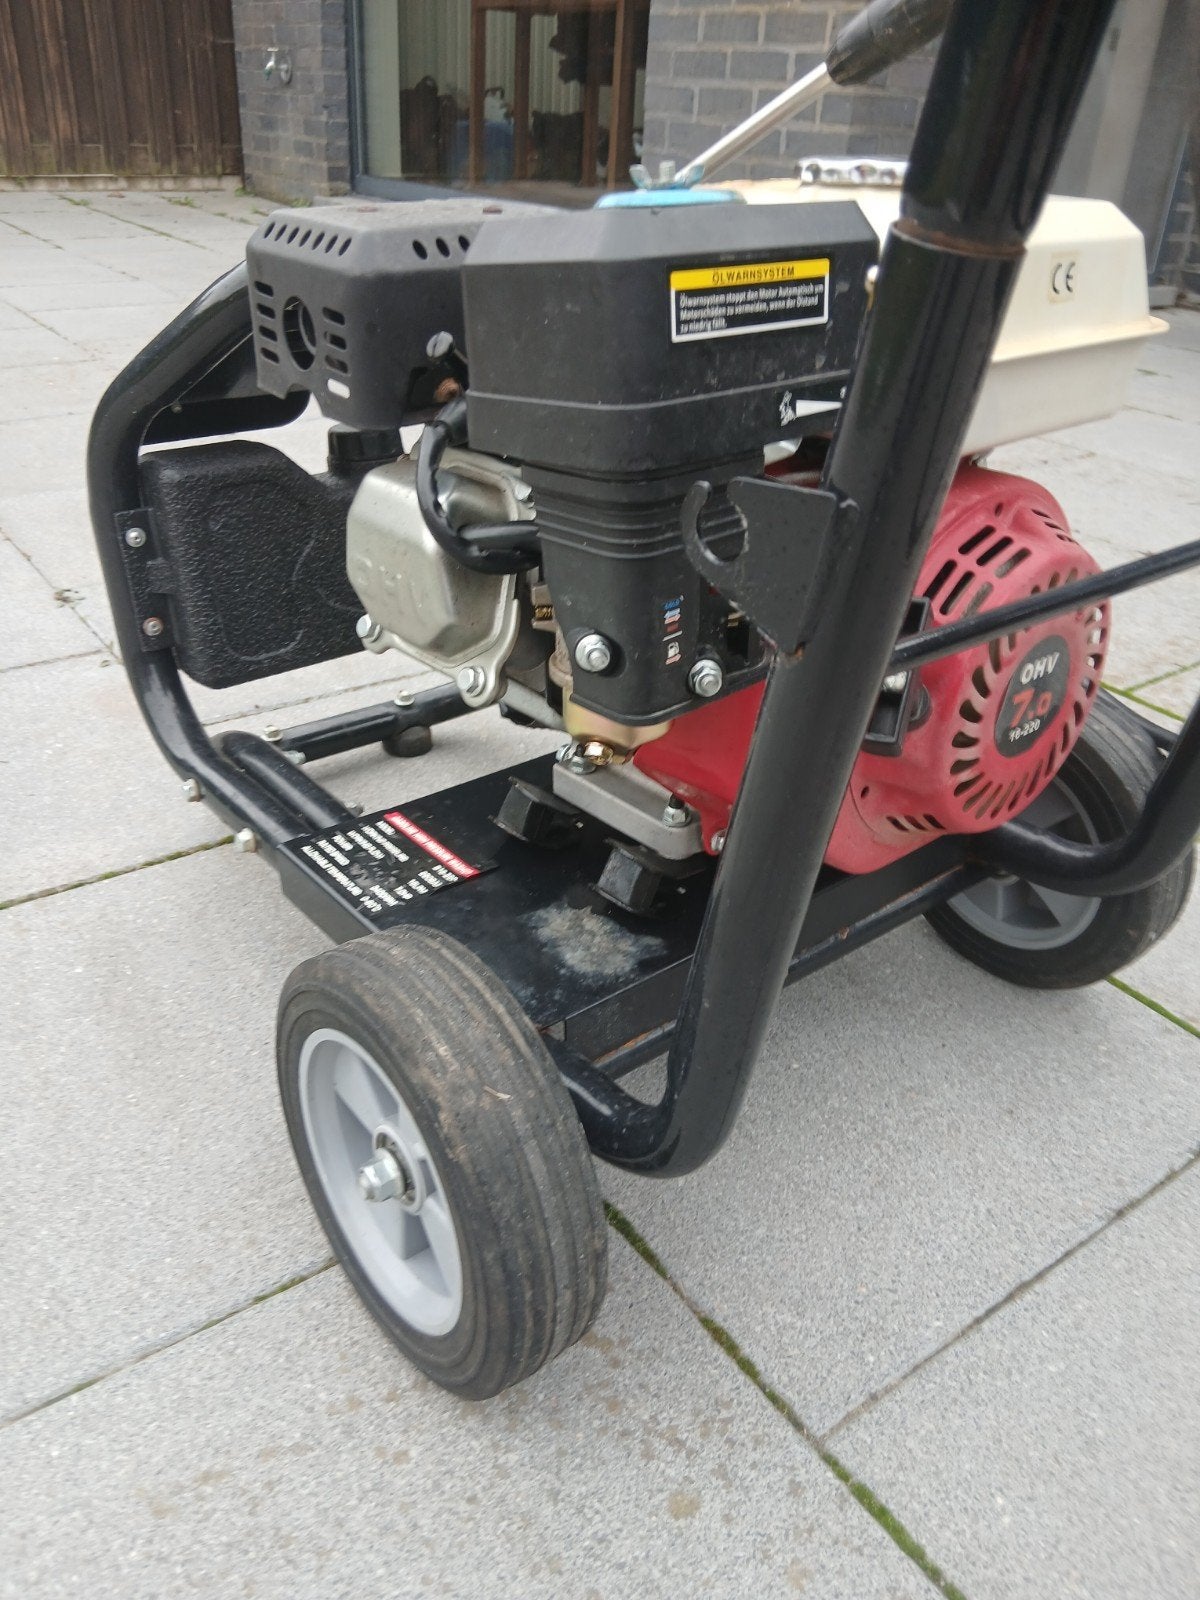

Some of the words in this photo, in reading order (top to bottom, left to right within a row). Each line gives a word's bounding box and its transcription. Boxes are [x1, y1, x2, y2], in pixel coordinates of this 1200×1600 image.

[712, 266, 794, 284] ÖLWARNSYSTEM
[1052, 262, 1076, 294] CE
[1020, 652, 1060, 685] OHV
[1010, 688, 1052, 727] 7.0
